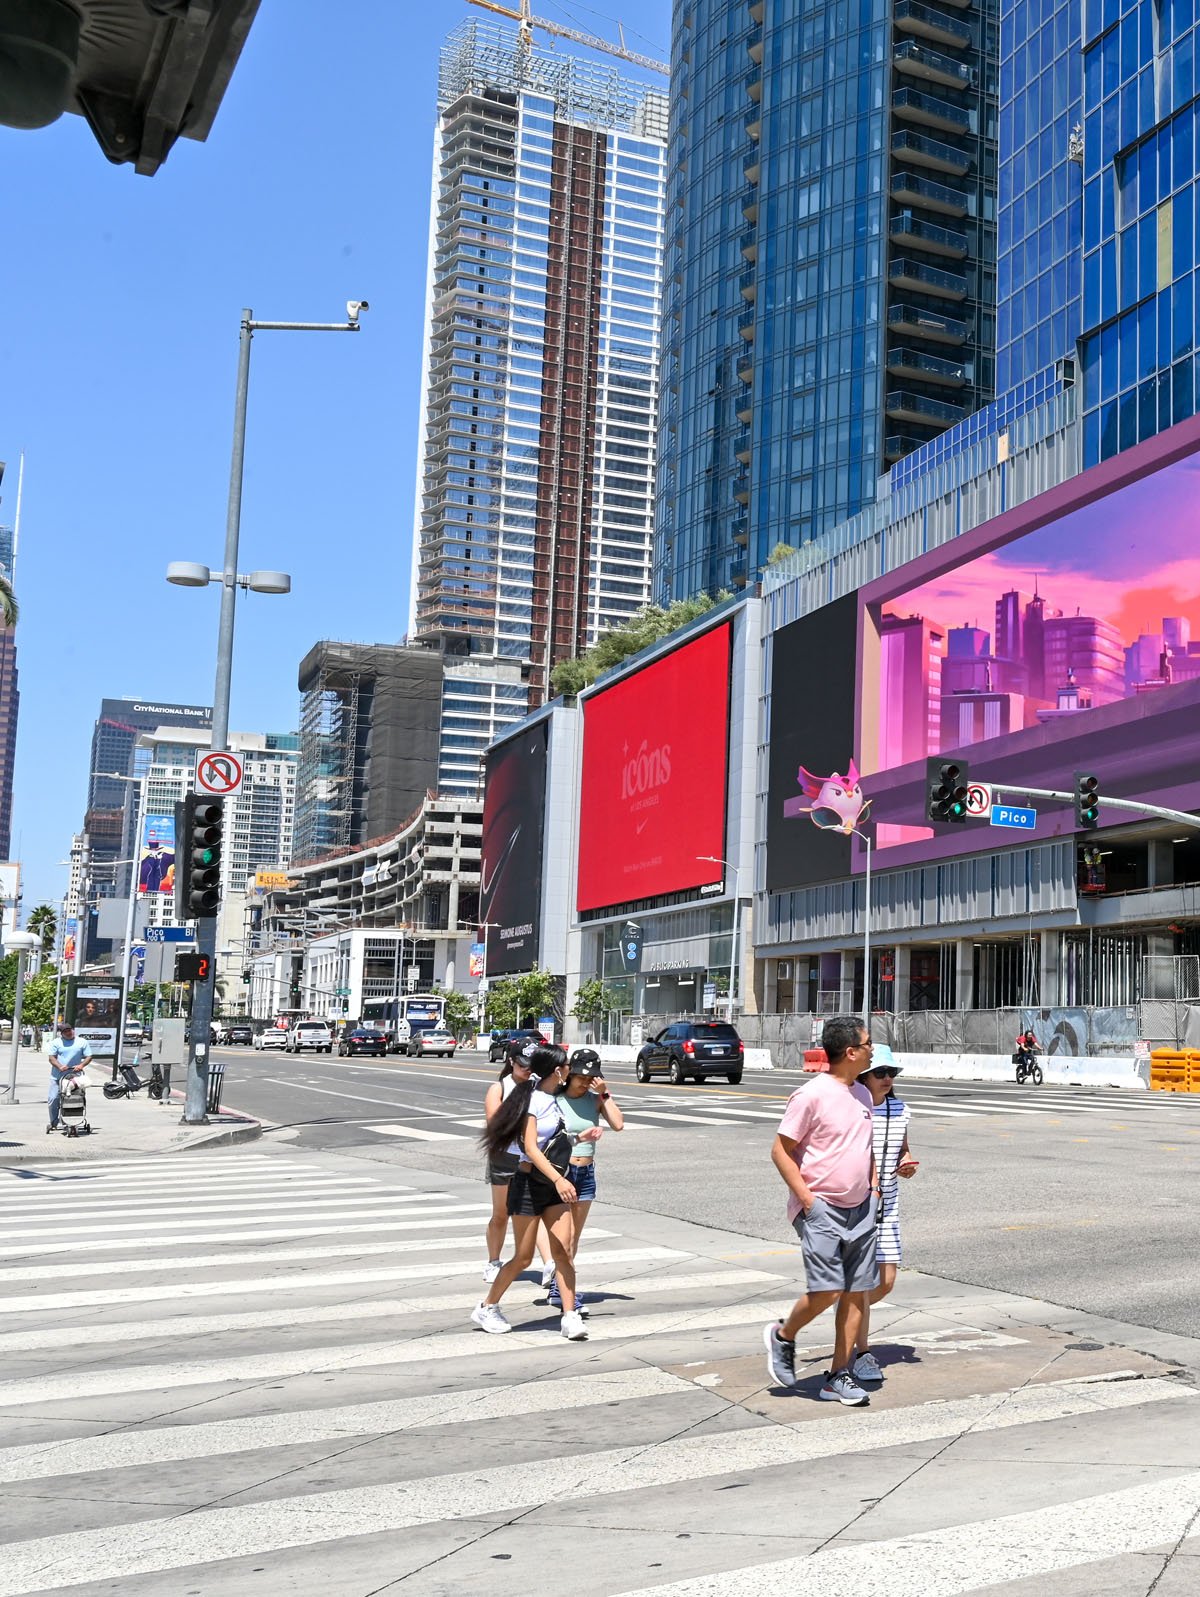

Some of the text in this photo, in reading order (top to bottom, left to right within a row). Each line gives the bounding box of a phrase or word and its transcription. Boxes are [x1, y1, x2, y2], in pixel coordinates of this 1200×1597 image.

[621, 739, 671, 801] icons
[1000, 810, 1027, 824] Pico
[147, 928, 164, 936] Pico
[198, 959, 209, 977] 2
